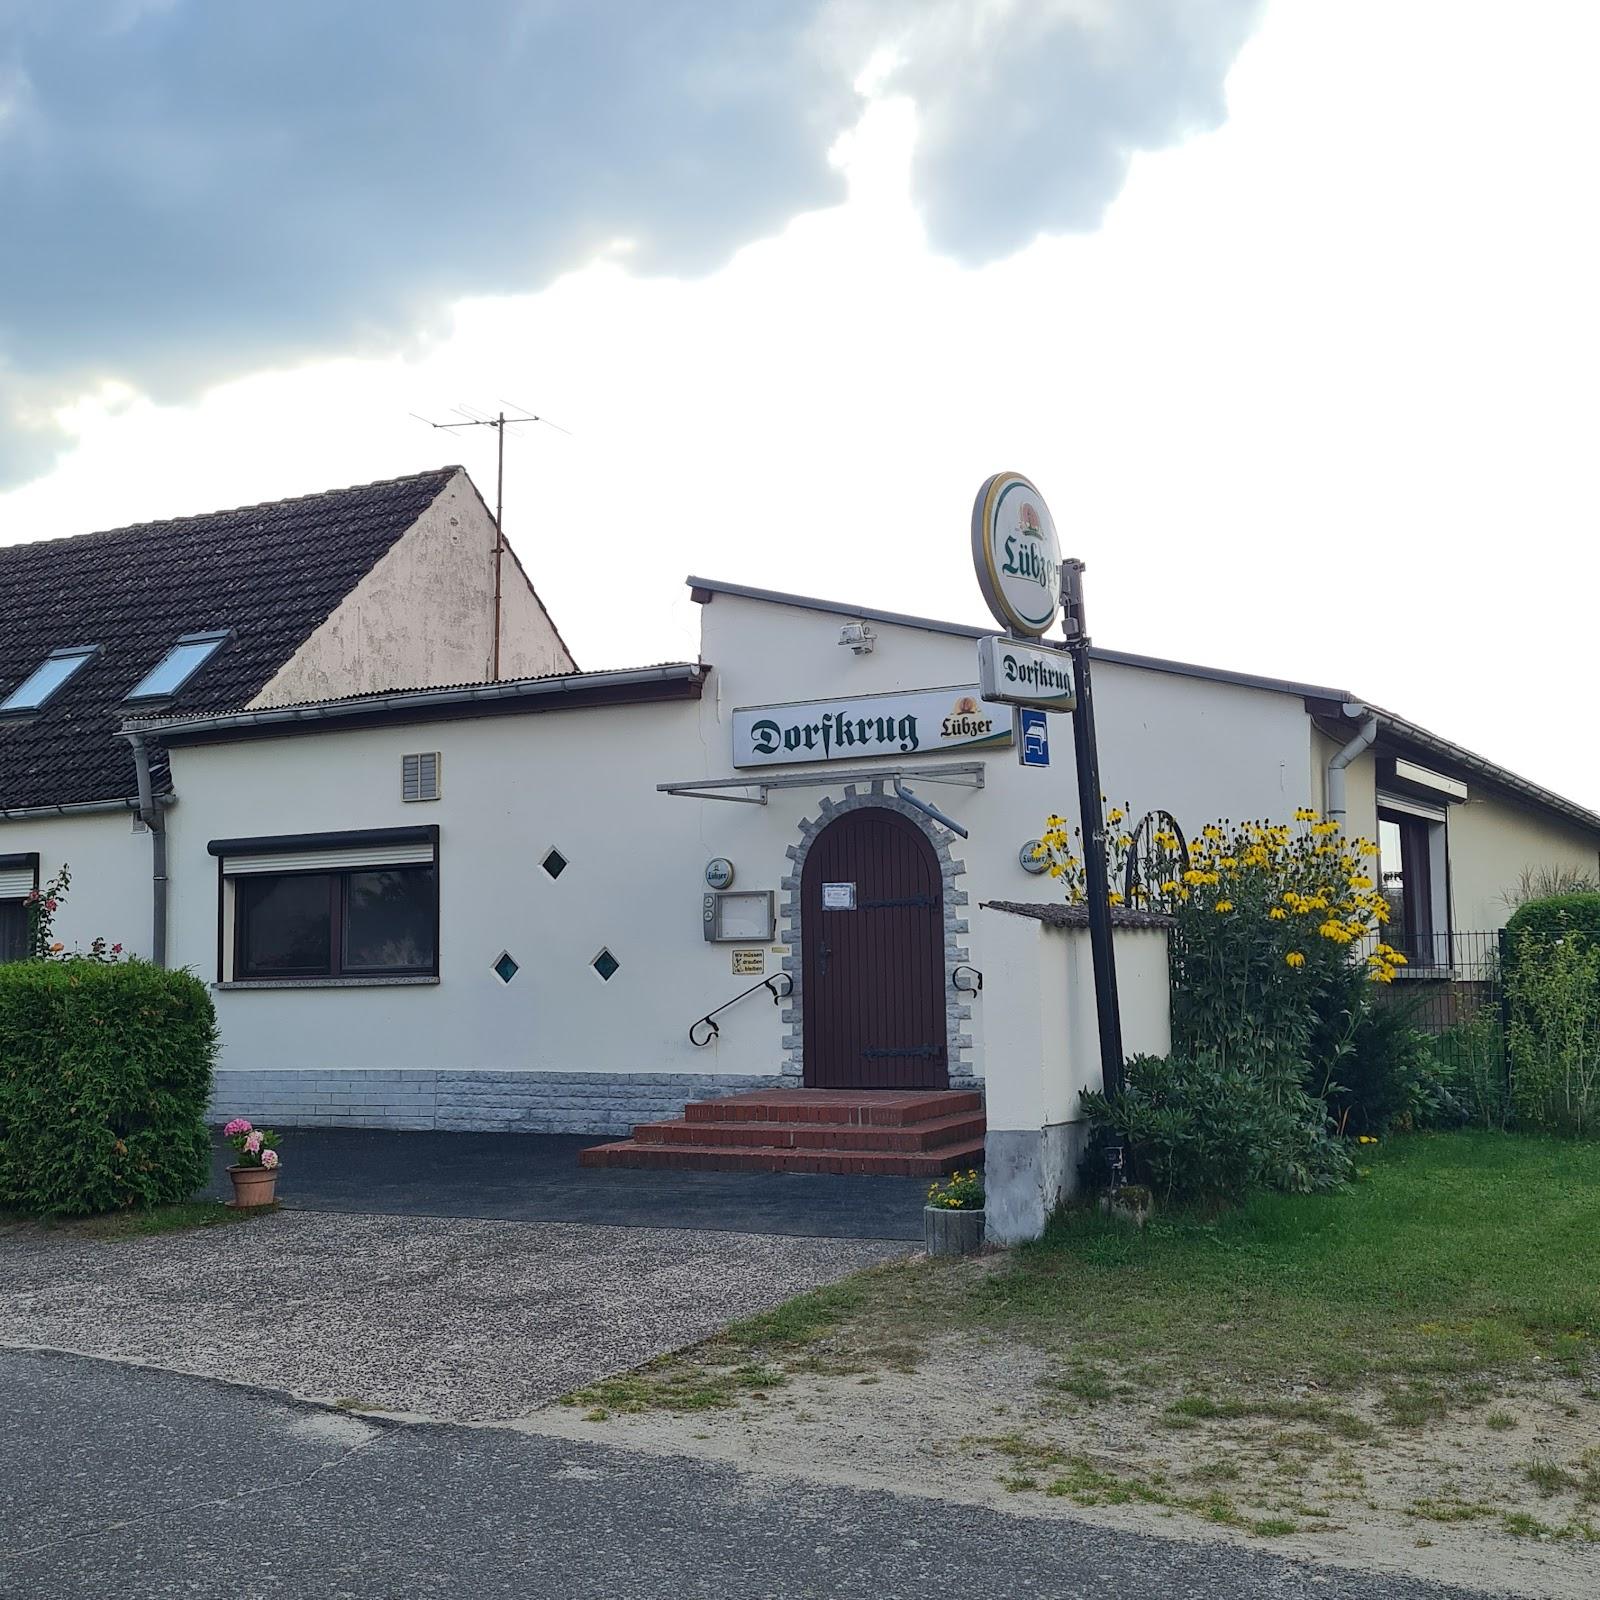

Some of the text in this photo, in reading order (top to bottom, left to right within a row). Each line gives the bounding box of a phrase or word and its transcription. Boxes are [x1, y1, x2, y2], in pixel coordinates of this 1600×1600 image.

[1002, 535, 1057, 588] Lübzer
[1003, 654, 1072, 698] Dorfkrug
[751, 711, 918, 759] Dorfkrug
[940, 716, 993, 737] Lübzer
